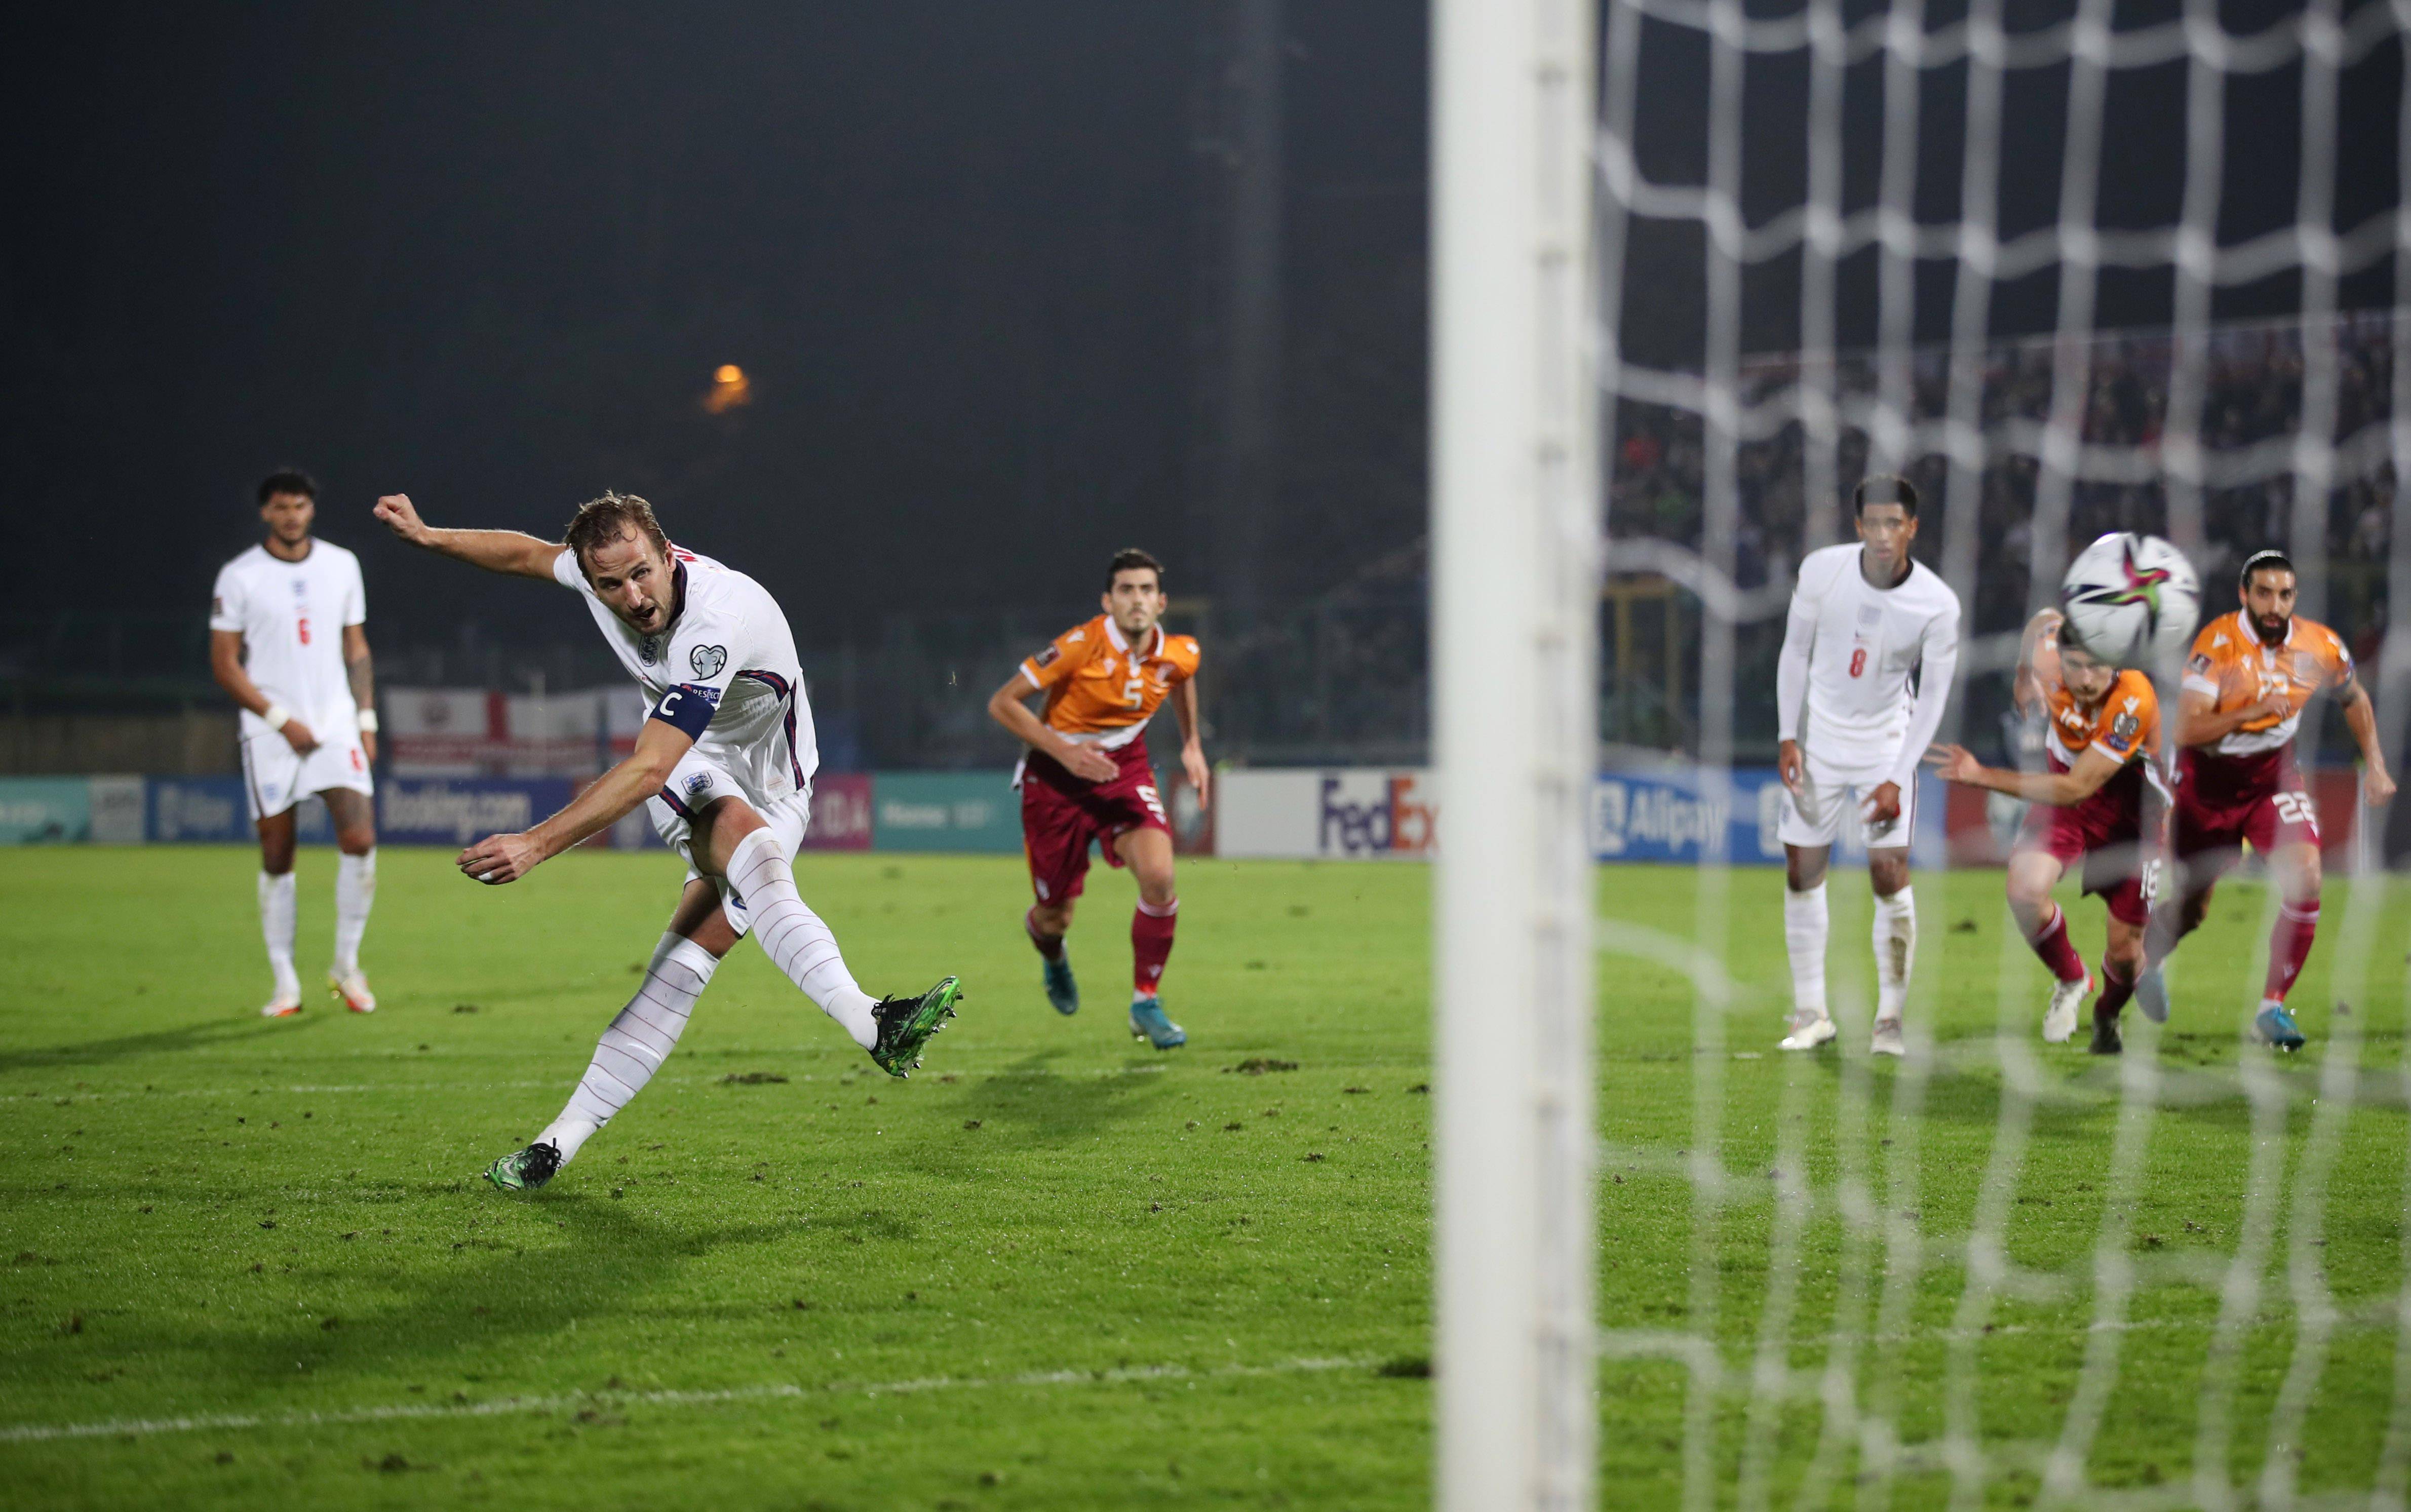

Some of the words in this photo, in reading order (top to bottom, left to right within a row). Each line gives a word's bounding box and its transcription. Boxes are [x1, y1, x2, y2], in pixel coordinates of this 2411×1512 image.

[298, 618, 310, 645] 6
[1849, 648, 1867, 678] 8
[659, 692, 683, 716] C
[1122, 679, 1144, 709] 5
[1320, 778, 1438, 851] FedEx
